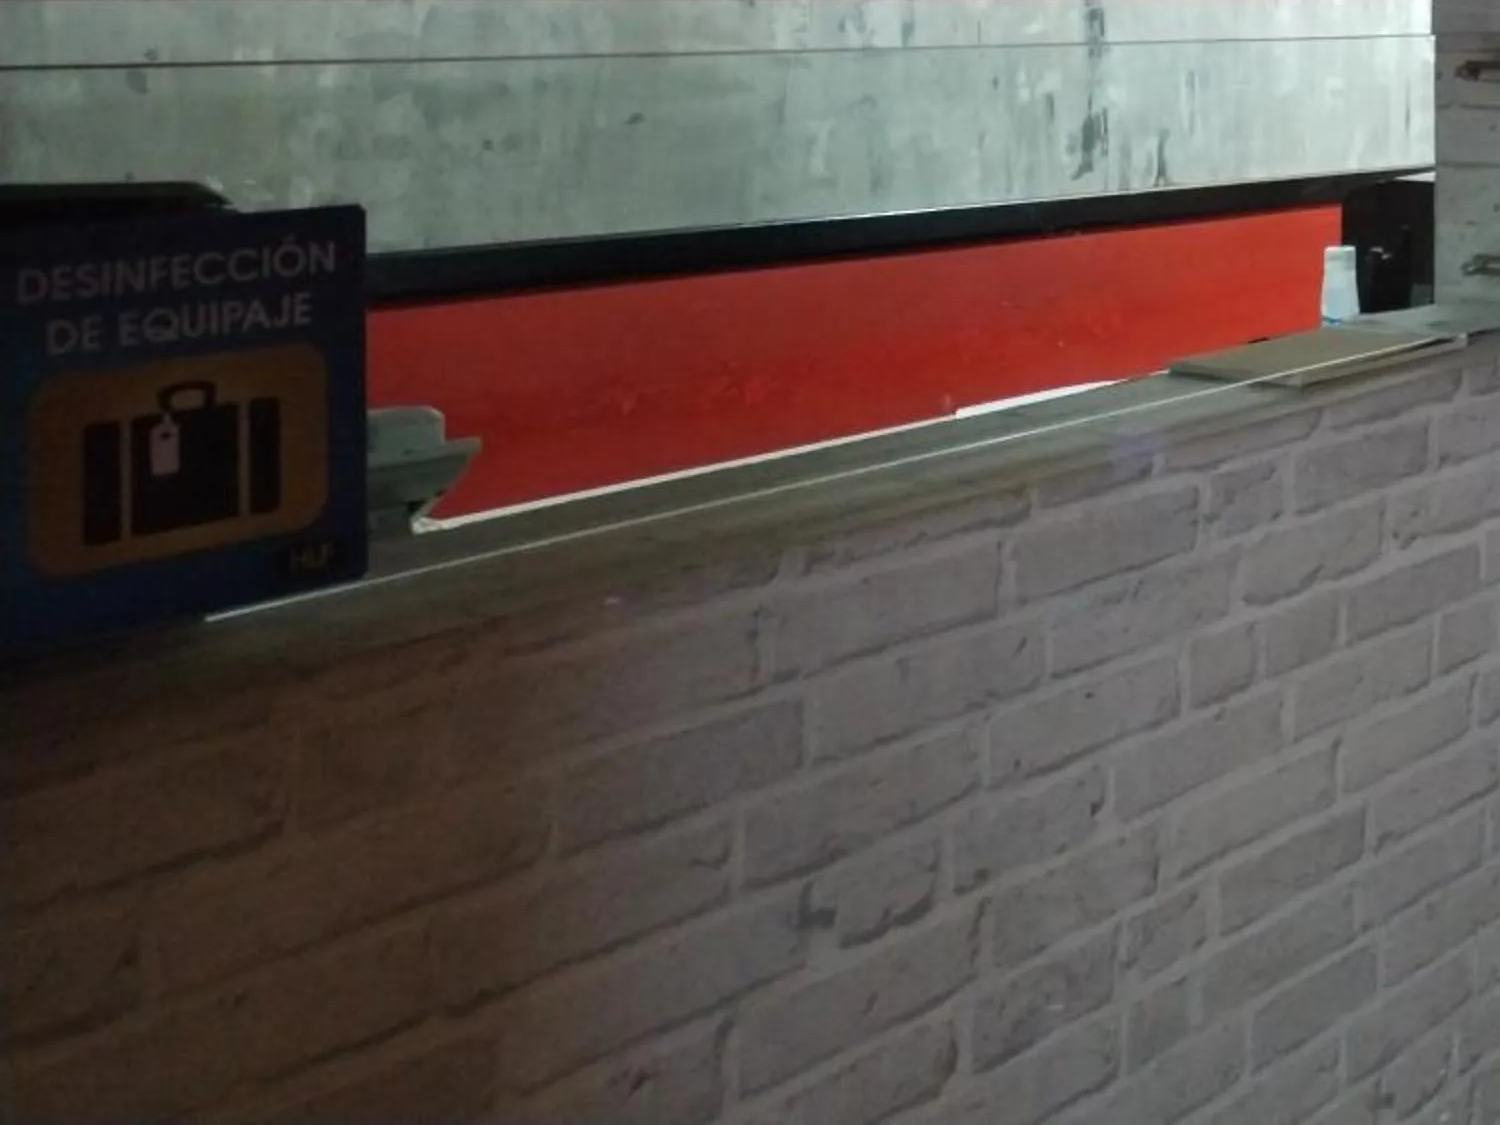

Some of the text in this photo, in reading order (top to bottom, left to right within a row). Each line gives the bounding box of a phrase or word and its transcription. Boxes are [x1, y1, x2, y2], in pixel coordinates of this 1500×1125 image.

[14, 234, 337, 306] DESINFECCIÓN
[44, 291, 314, 356] DE EQUIPAJE
